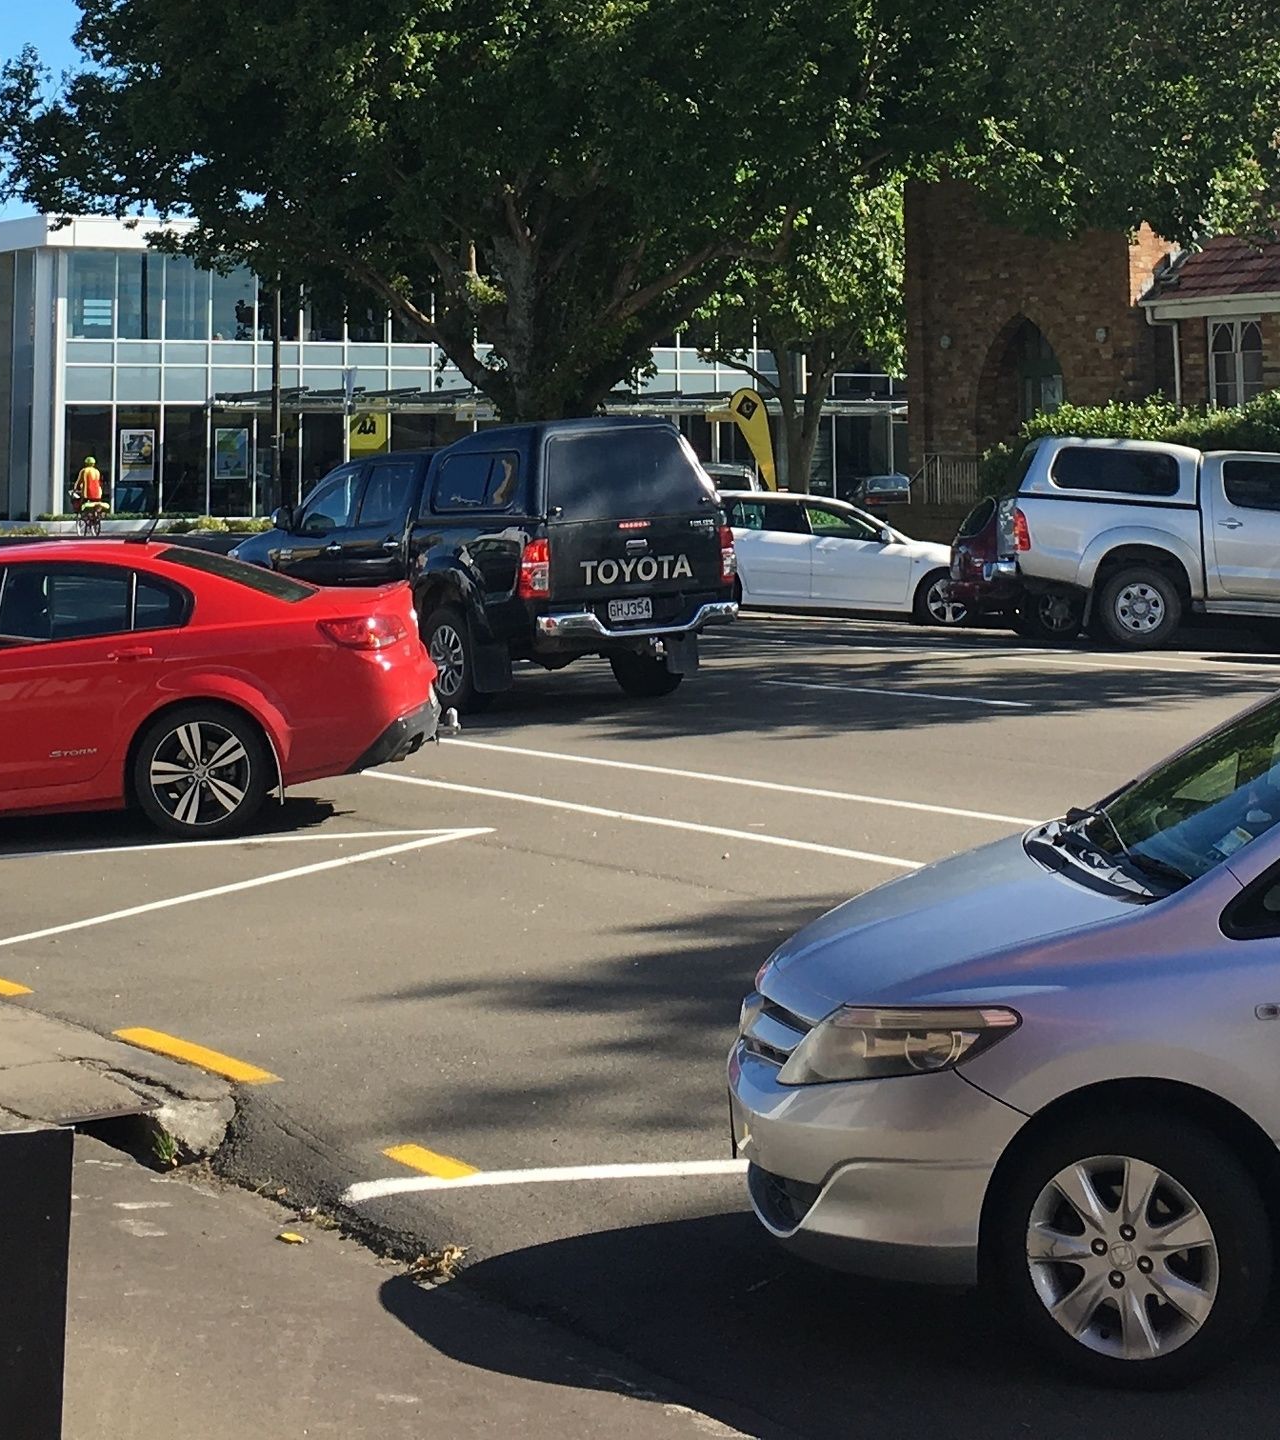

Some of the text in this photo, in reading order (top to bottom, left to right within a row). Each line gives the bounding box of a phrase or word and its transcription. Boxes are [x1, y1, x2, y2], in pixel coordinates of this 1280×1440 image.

[357, 420, 376, 434] AA
[579, 554, 693, 585] TOYOTA
[610, 600, 651, 617] GHJ354
